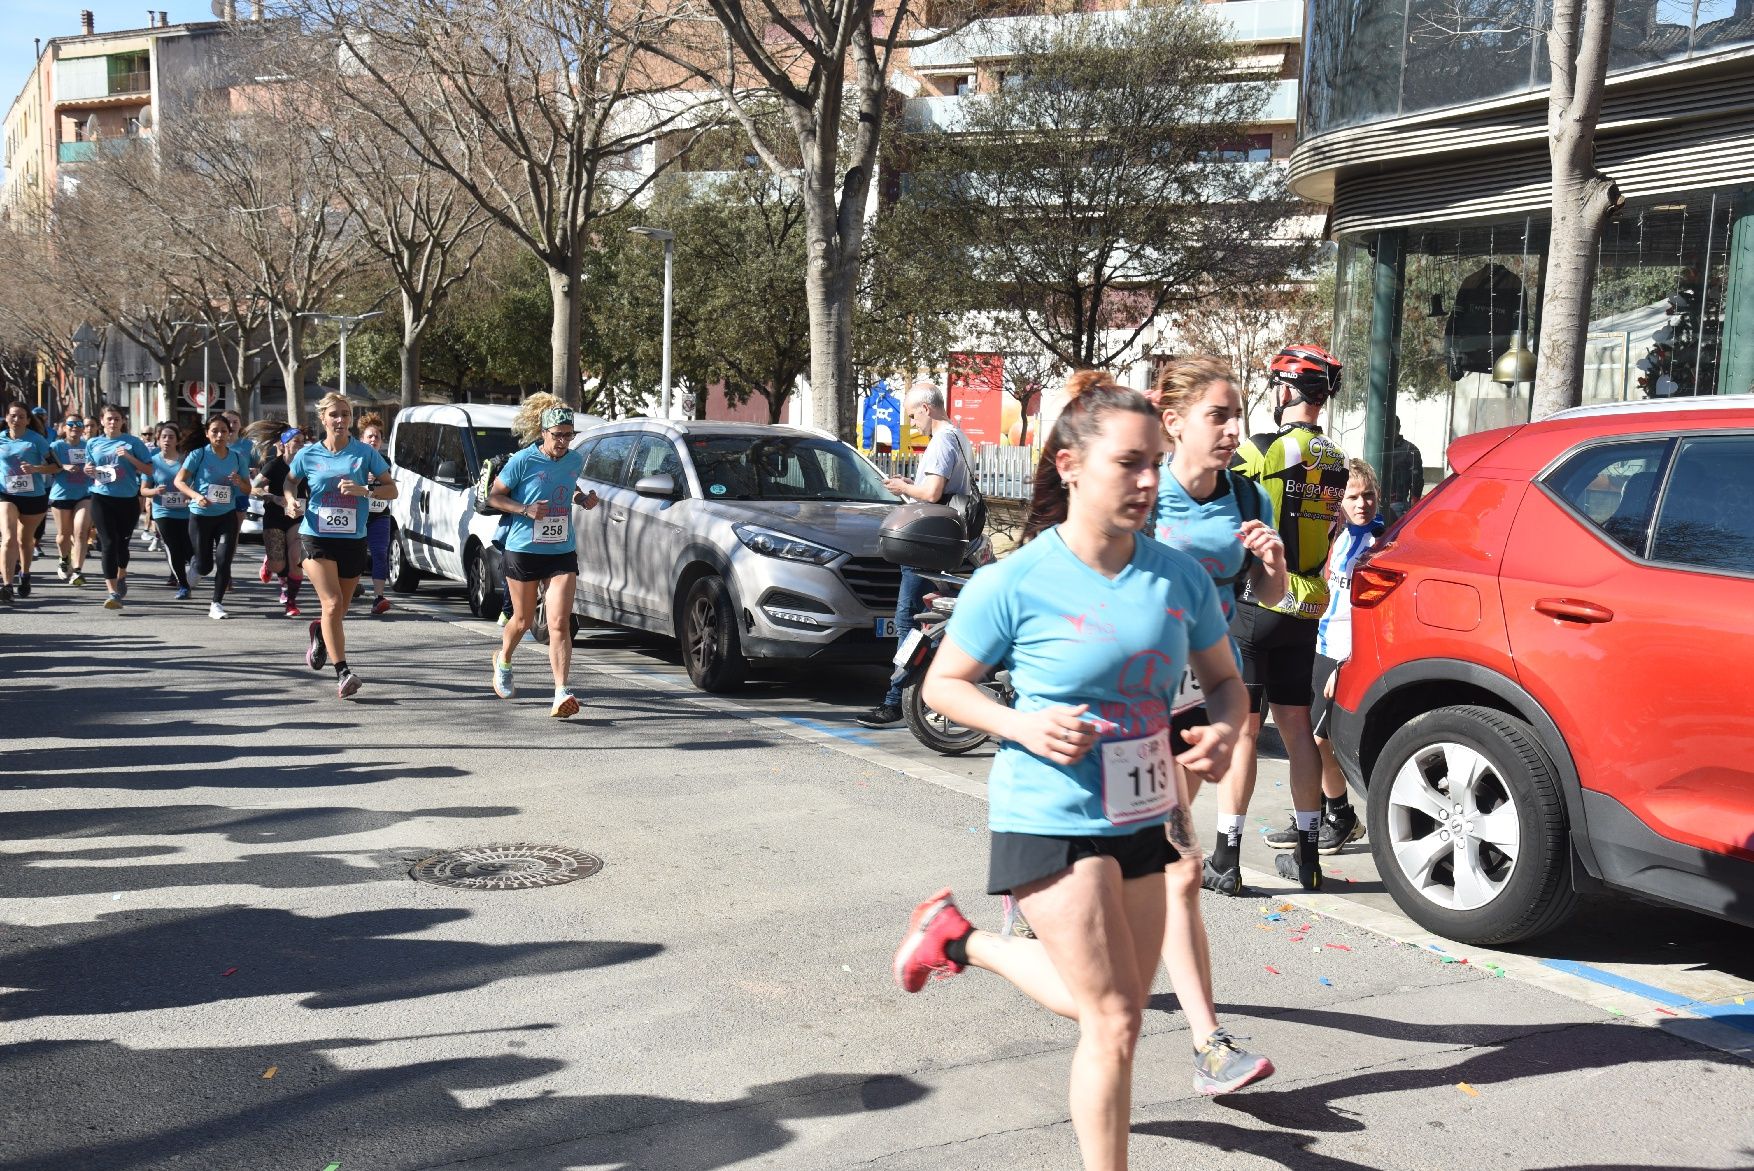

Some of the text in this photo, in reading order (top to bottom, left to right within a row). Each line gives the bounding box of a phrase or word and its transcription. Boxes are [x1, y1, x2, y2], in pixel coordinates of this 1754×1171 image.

[12, 480, 28, 488] 290
[326, 515, 349, 526] 263
[542, 525, 563, 536] 258
[1128, 760, 1168, 797] 113
